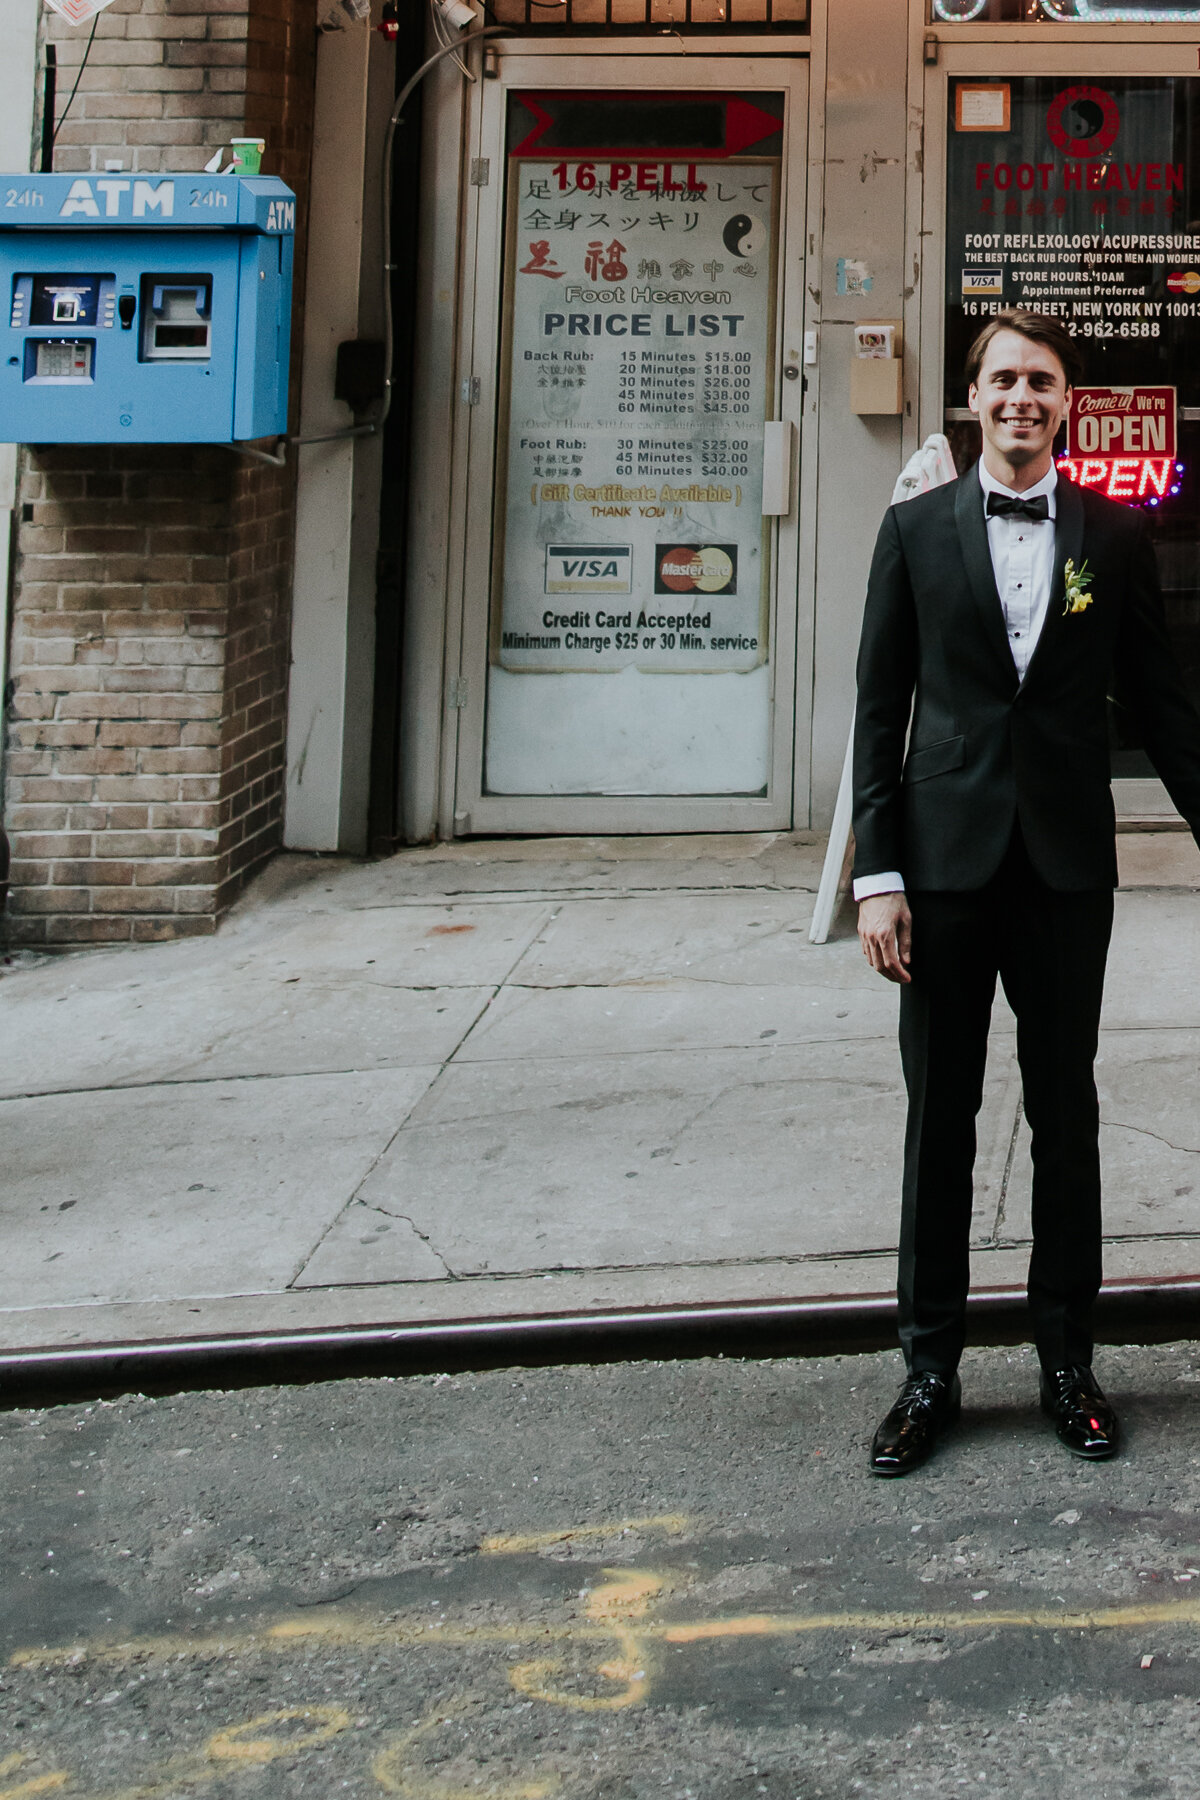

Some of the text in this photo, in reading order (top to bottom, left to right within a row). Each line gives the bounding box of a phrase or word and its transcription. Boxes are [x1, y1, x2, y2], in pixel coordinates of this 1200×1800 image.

[552, 163, 706, 192] 16 PELL
[974, 162, 1185, 191] FOOT HEAVEN
[5, 179, 229, 218] 24h ATM 24h
[266, 200, 295, 232] ATM
[965, 234, 1200, 250] FOOT REFLEXOLOGY ACUPRESSURE
[965, 252, 1200, 264] THE BEST BACK RUB FOOT RUB FOR MEN AND WOMEN
[971, 277, 995, 287] VISA
[1011, 271, 1048, 282] STORE
[1096, 272, 1125, 283] 10AM
[565, 286, 732, 305] Foot Heaven
[1022, 285, 1146, 297] Appointment Preferred
[962, 302, 978, 316] 16
[1016, 302, 1070, 319] STREET,
[1072, 302, 1102, 317] NEW
[1105, 302, 1141, 317] YORK
[1144, 302, 1163, 317] NY
[543, 313, 745, 338] PRICE LIST
[523, 350, 595, 362] Back Rub:
[620, 351, 752, 363] 15 Minutes $15.00
[1077, 394, 1116, 413] Come
[1136, 395, 1166, 410] We're
[1077, 415, 1166, 453] OPEN
[519, 438, 587, 450] Foot Rub:
[616, 439, 749, 451] 30 Minutes $25.00
[573, 484, 657, 502] Certificate
[590, 506, 632, 518] THANK
[638, 506, 665, 518] YOU
[562, 560, 619, 578] VISA
[661, 562, 731, 578] MasterCard
[542, 610, 712, 632] Credit Card Accepted
[501, 632, 758, 654] Minimum Charge $25 or 30 Min. service
